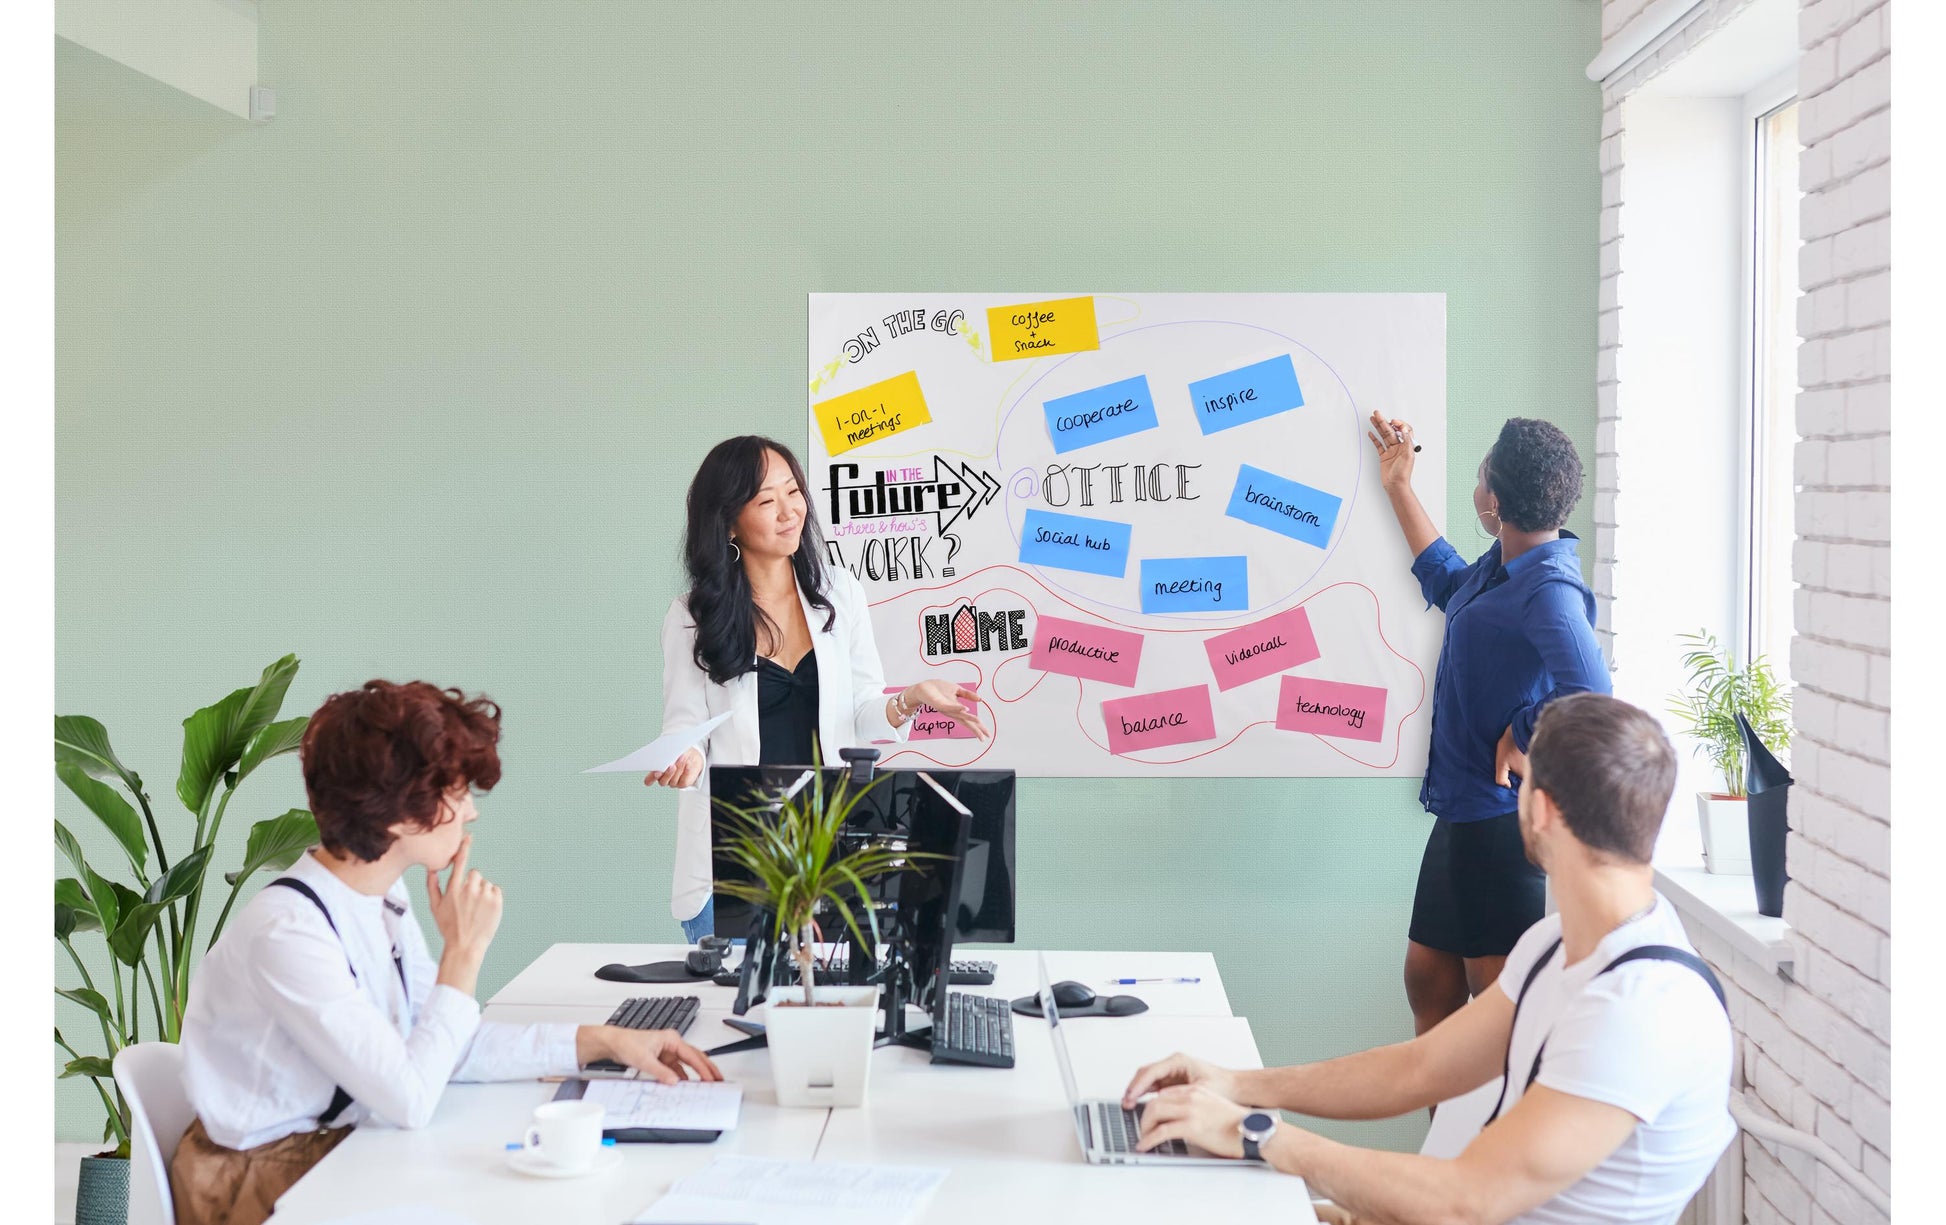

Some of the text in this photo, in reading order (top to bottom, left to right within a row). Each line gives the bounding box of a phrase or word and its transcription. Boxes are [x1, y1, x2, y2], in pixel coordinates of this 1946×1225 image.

[1011, 311, 1056, 330] coffee
[842, 326, 881, 364] ON
[882, 309, 926, 339] THE
[1202, 387, 1258, 413] inspire
[835, 403, 886, 431] 1-on-1
[1056, 398, 1139, 432] cooperate
[846, 413, 902, 446] meetings
[885, 467, 924, 483] IN THE
[829, 463, 962, 524] future
[1245, 484, 1321, 528] brainstorm
[833, 520, 877, 537] where
[879, 520, 888, 534] &
[1085, 535, 1111, 551] hub
[1154, 579, 1223, 602] meeting
[1048, 636, 1120, 663] productive
[1121, 712, 1188, 736] balance
[1296, 695, 1366, 729] technology
[913, 719, 956, 735] laptop
